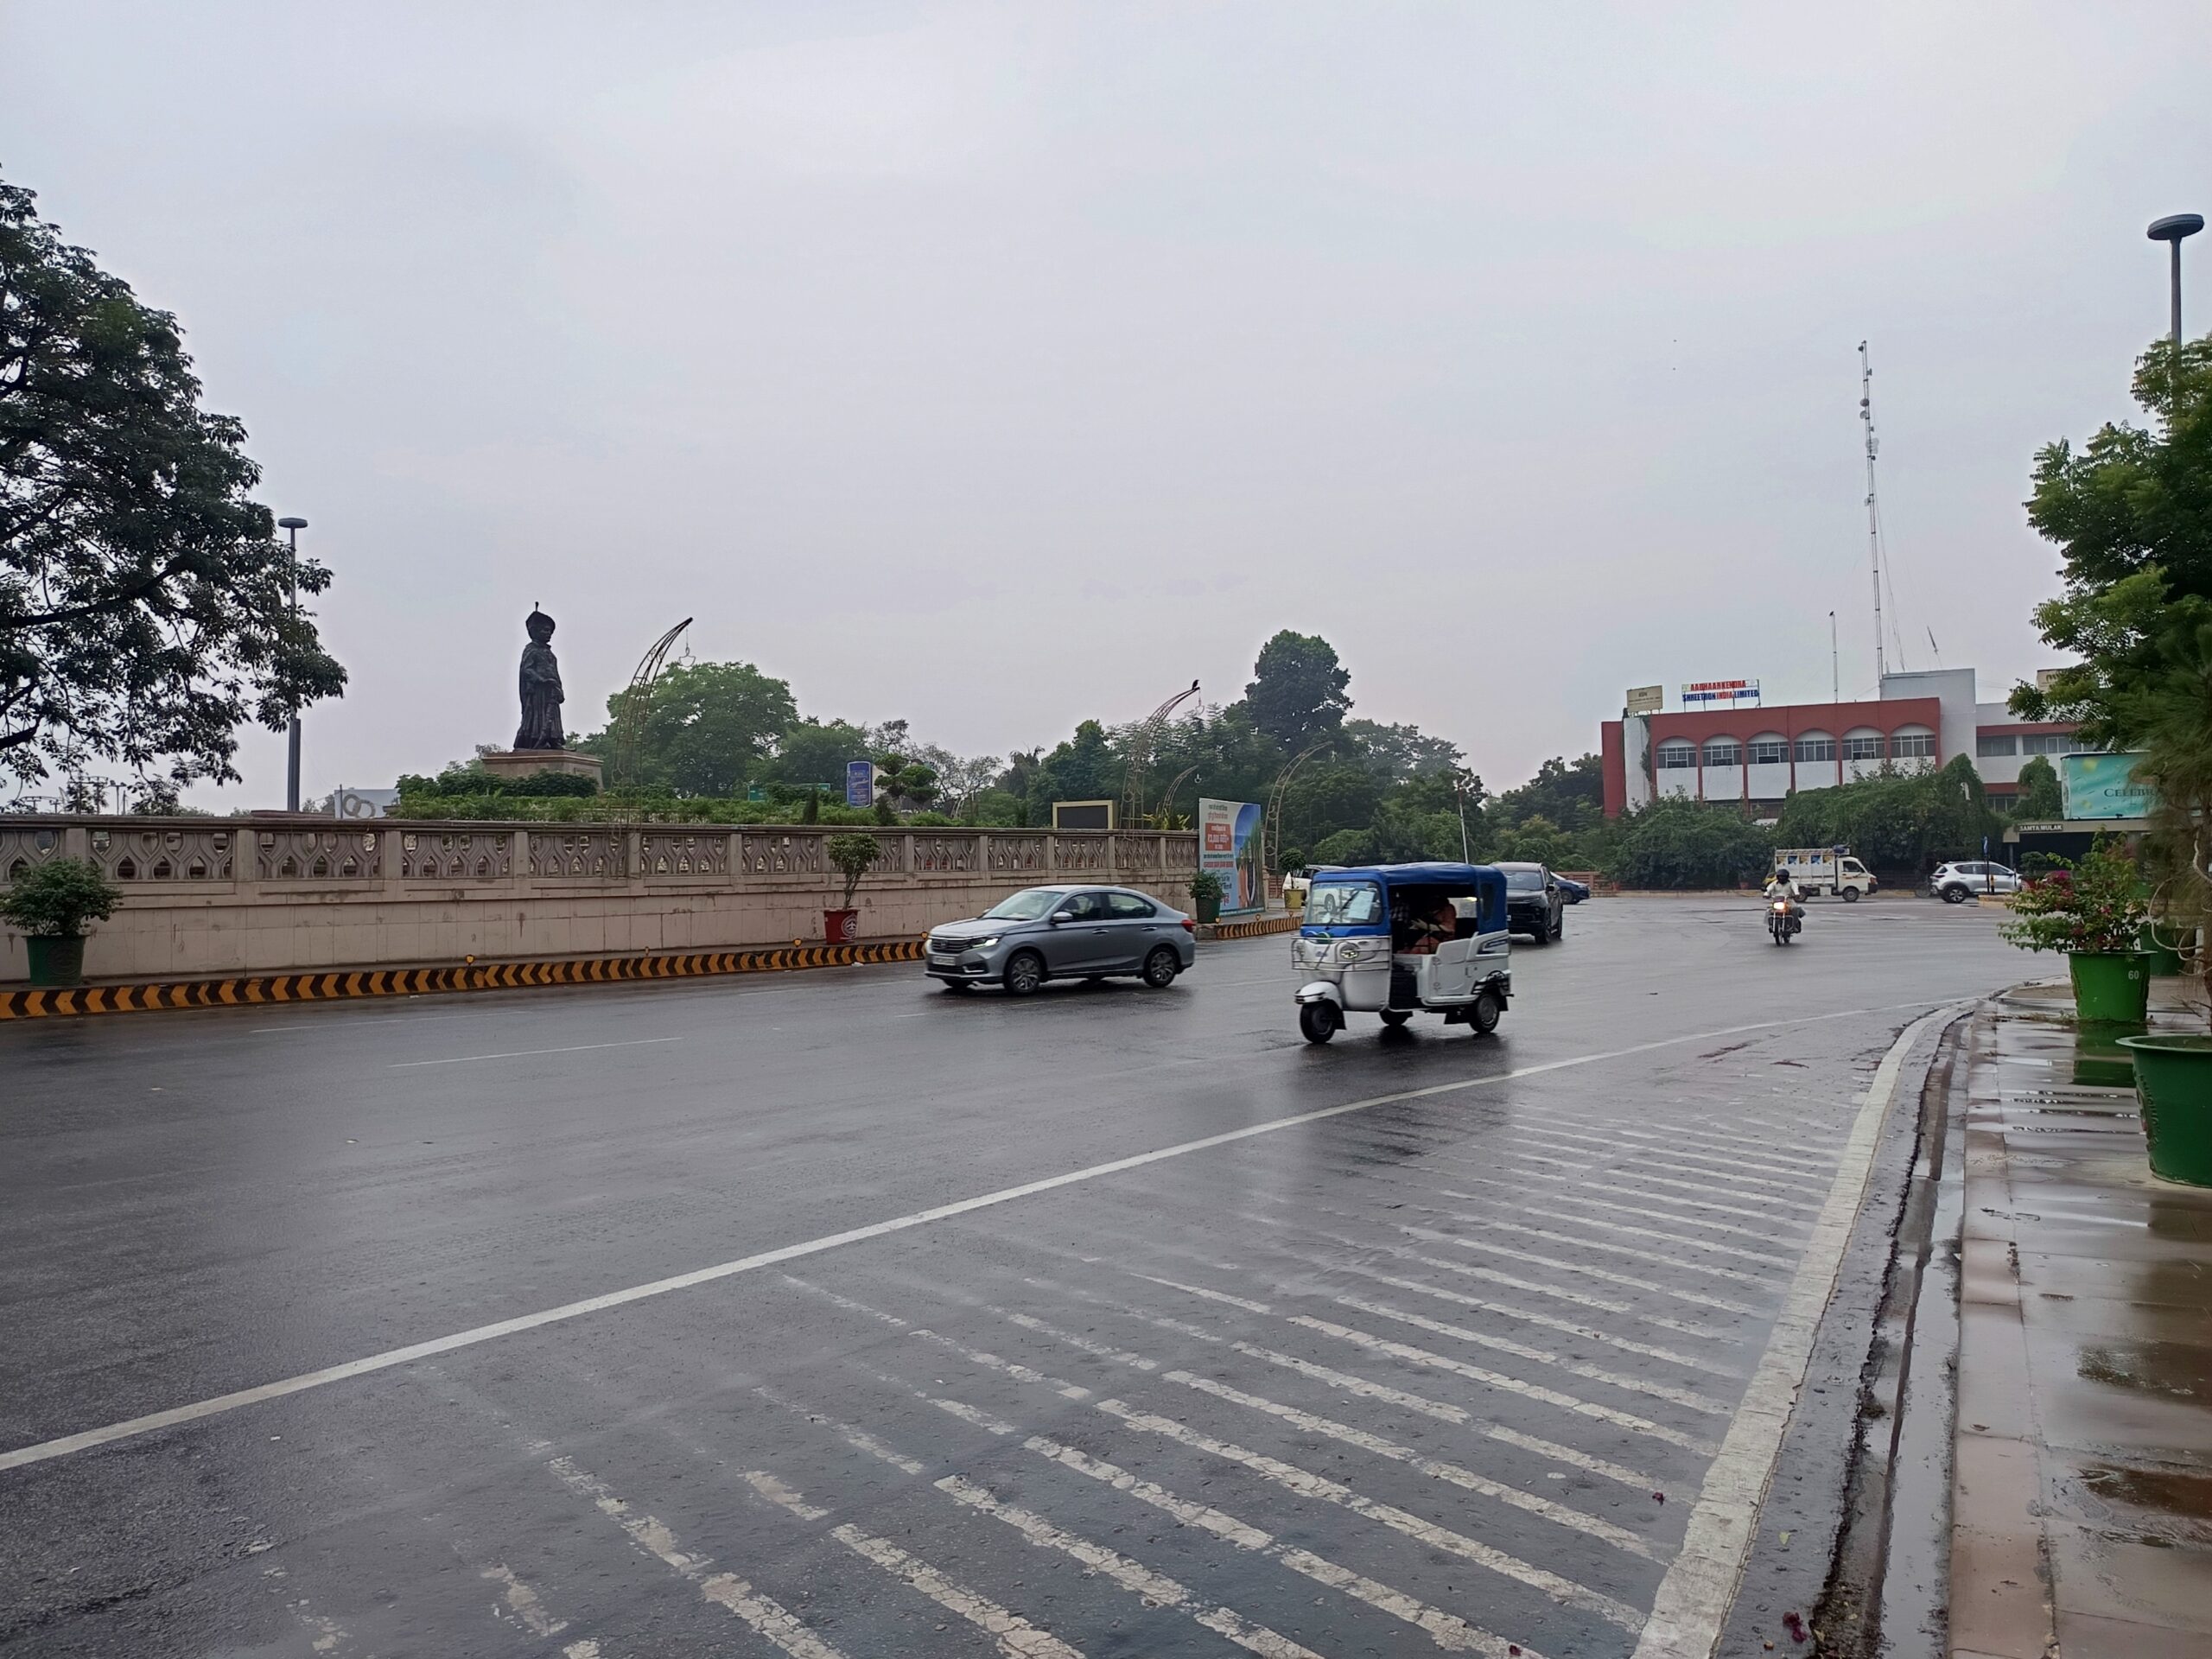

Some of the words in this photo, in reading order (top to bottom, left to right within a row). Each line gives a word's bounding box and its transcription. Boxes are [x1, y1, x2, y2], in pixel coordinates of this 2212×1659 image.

[1717, 690, 1733, 700] INDIA
[1734, 690, 1759, 699] LIMITED
[2128, 969, 2139, 980] 60
